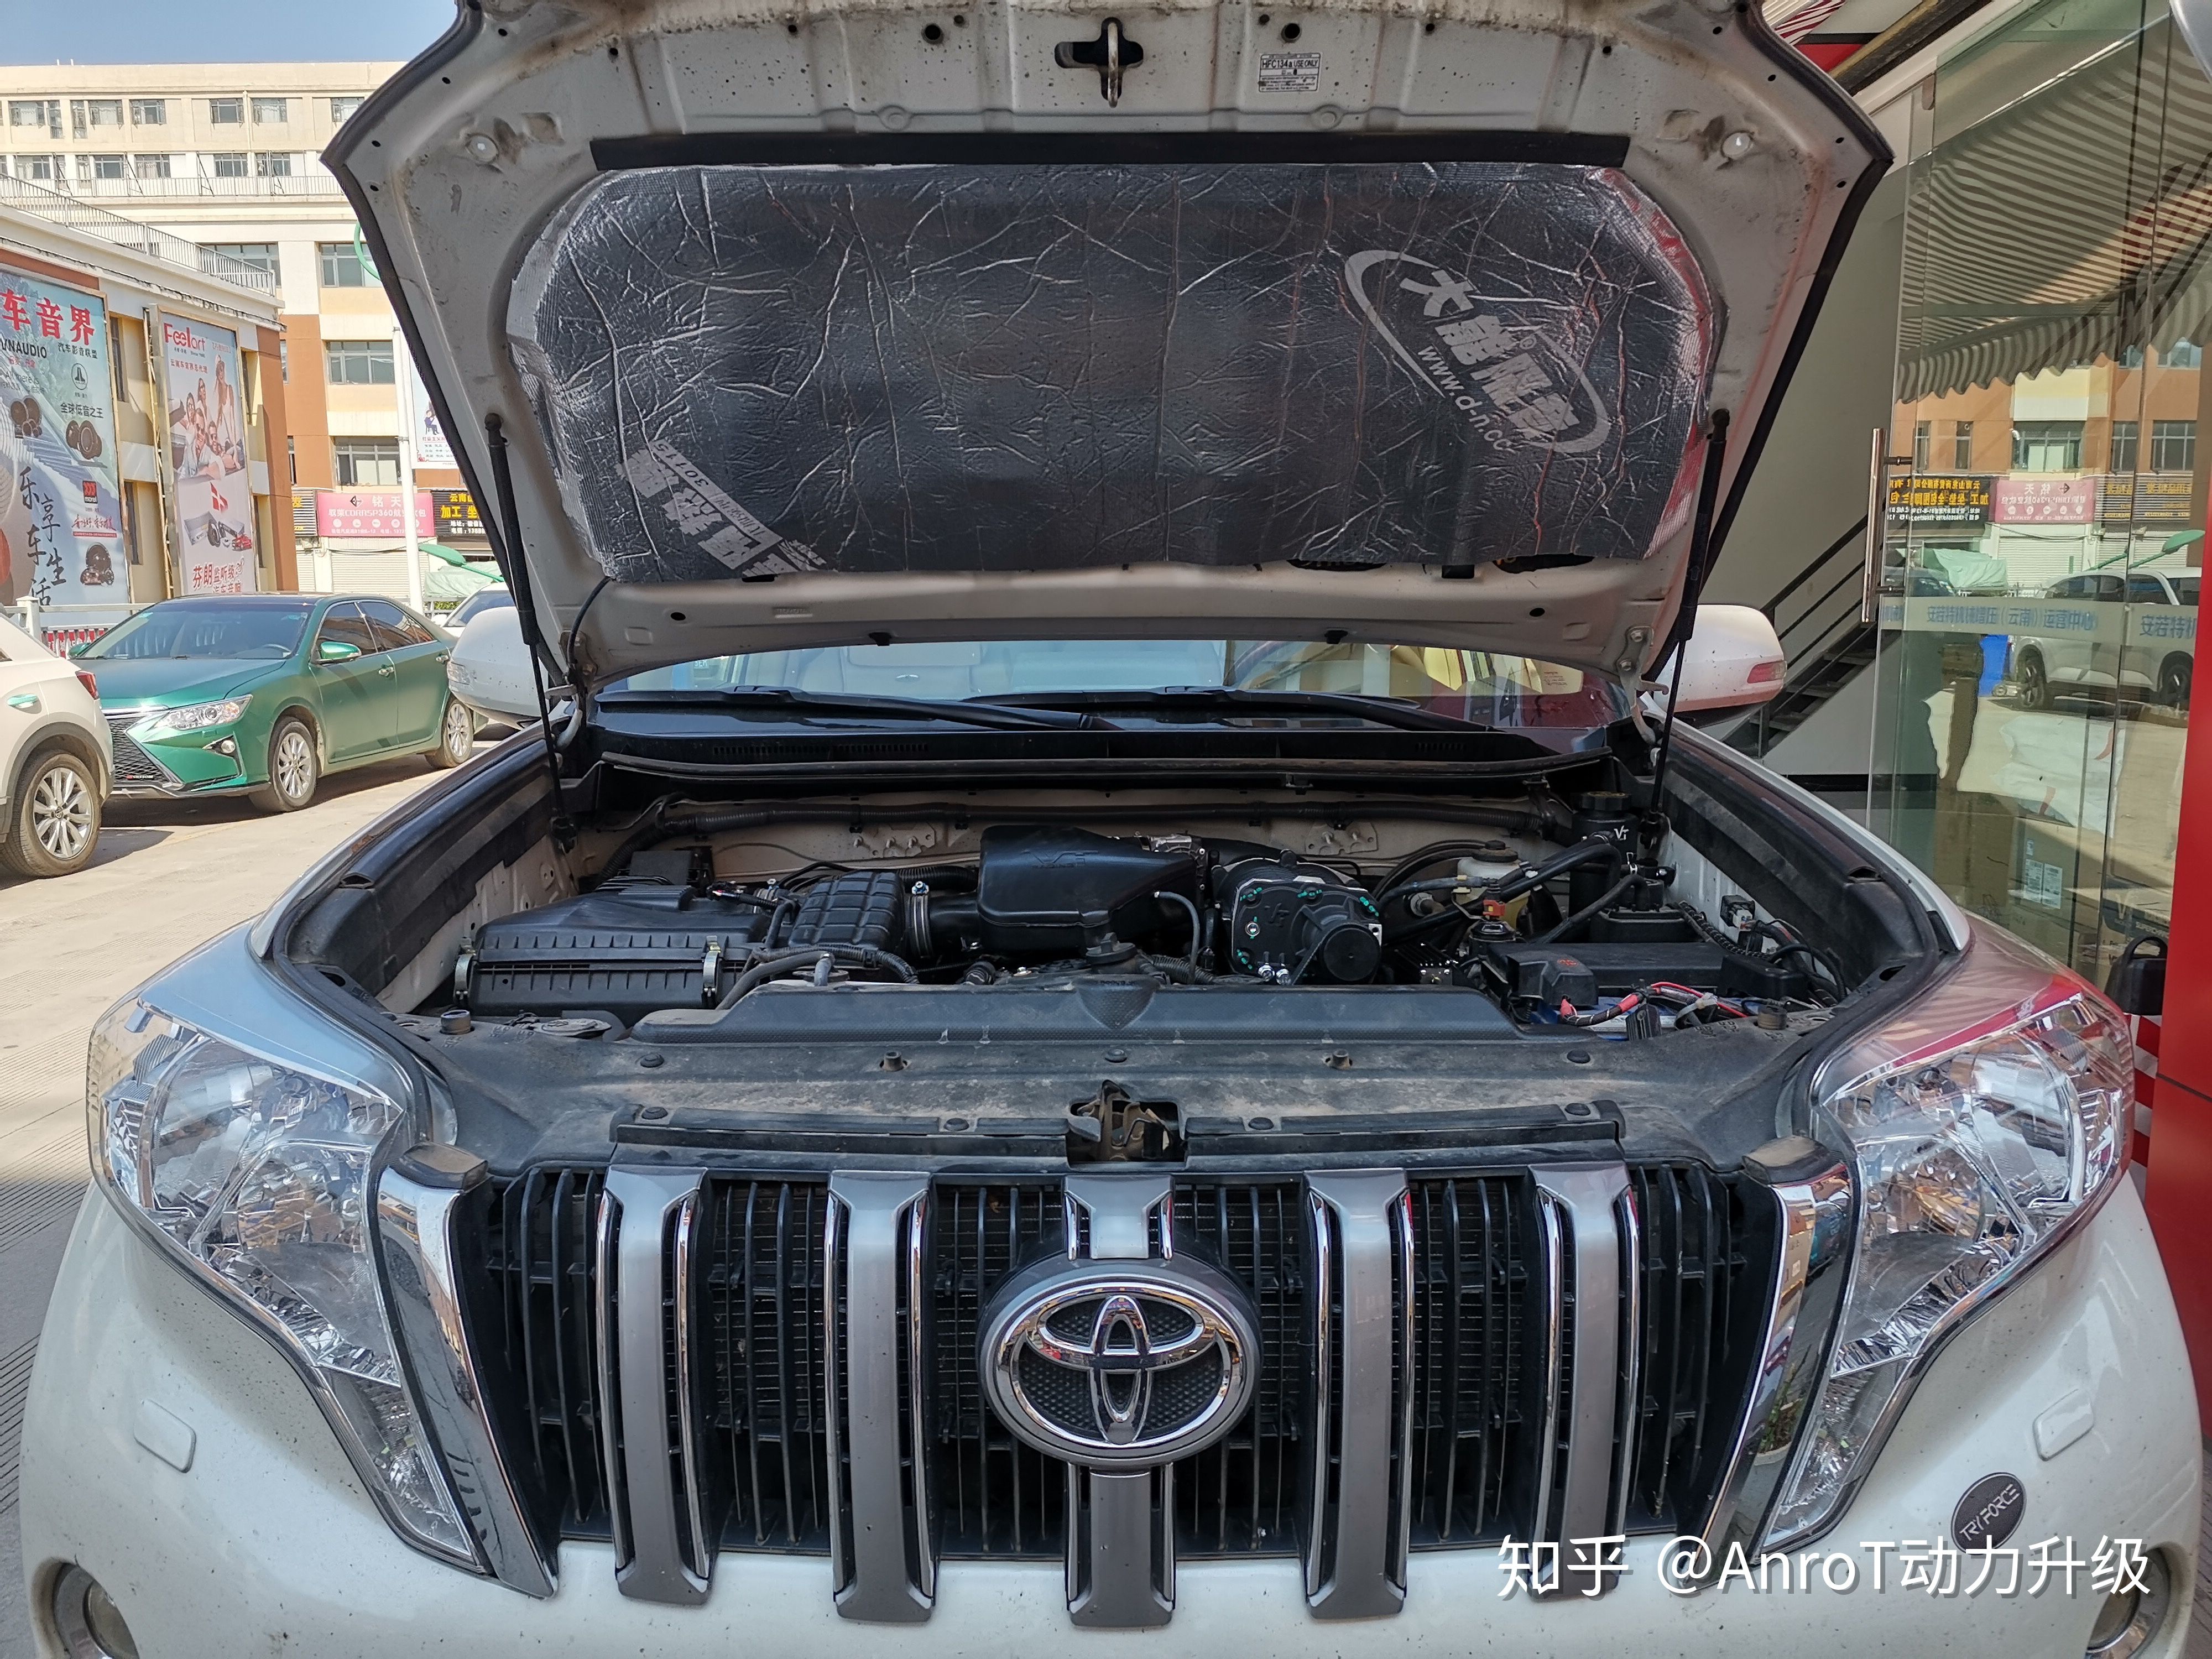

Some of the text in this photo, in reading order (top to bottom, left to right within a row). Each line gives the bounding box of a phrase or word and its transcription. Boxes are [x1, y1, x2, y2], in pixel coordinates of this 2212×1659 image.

[0, 288, 95, 346] 车音界
[60, 402, 104, 419] 全球低音之王
[441, 505, 462, 519] 加工
